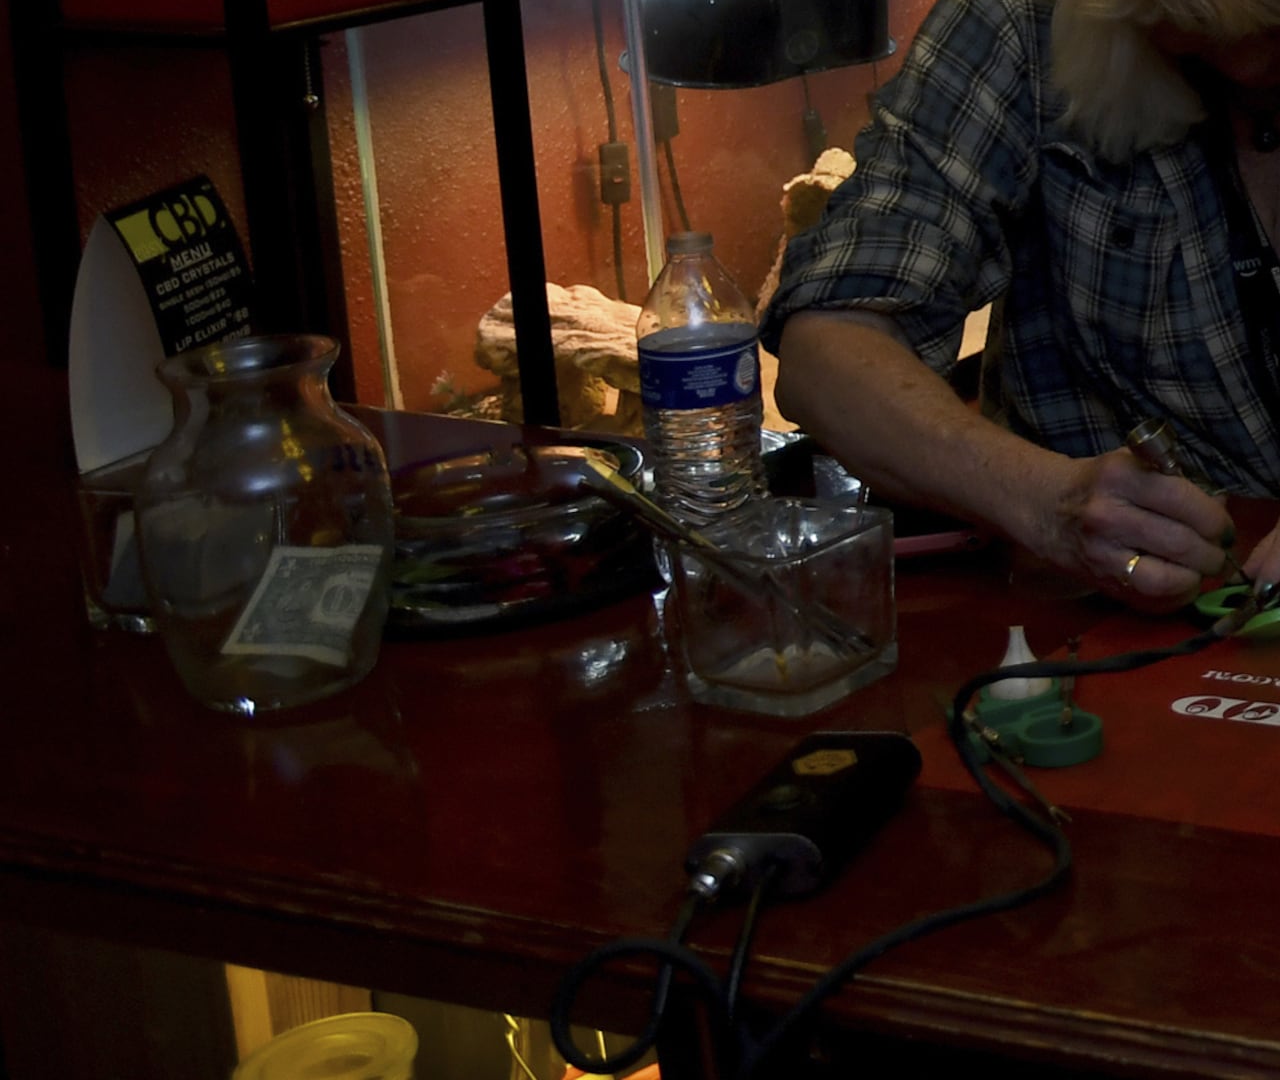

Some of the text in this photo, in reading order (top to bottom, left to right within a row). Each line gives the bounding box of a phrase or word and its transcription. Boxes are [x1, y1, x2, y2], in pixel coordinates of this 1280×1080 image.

[149, 193, 219, 247] CBD
[169, 241, 214, 272] MENU
[1233, 257, 1262, 271] wm
[155, 276, 180, 296] CBD
[181, 251, 236, 284] CRYSTALS
[175, 335, 193, 353] LIP
